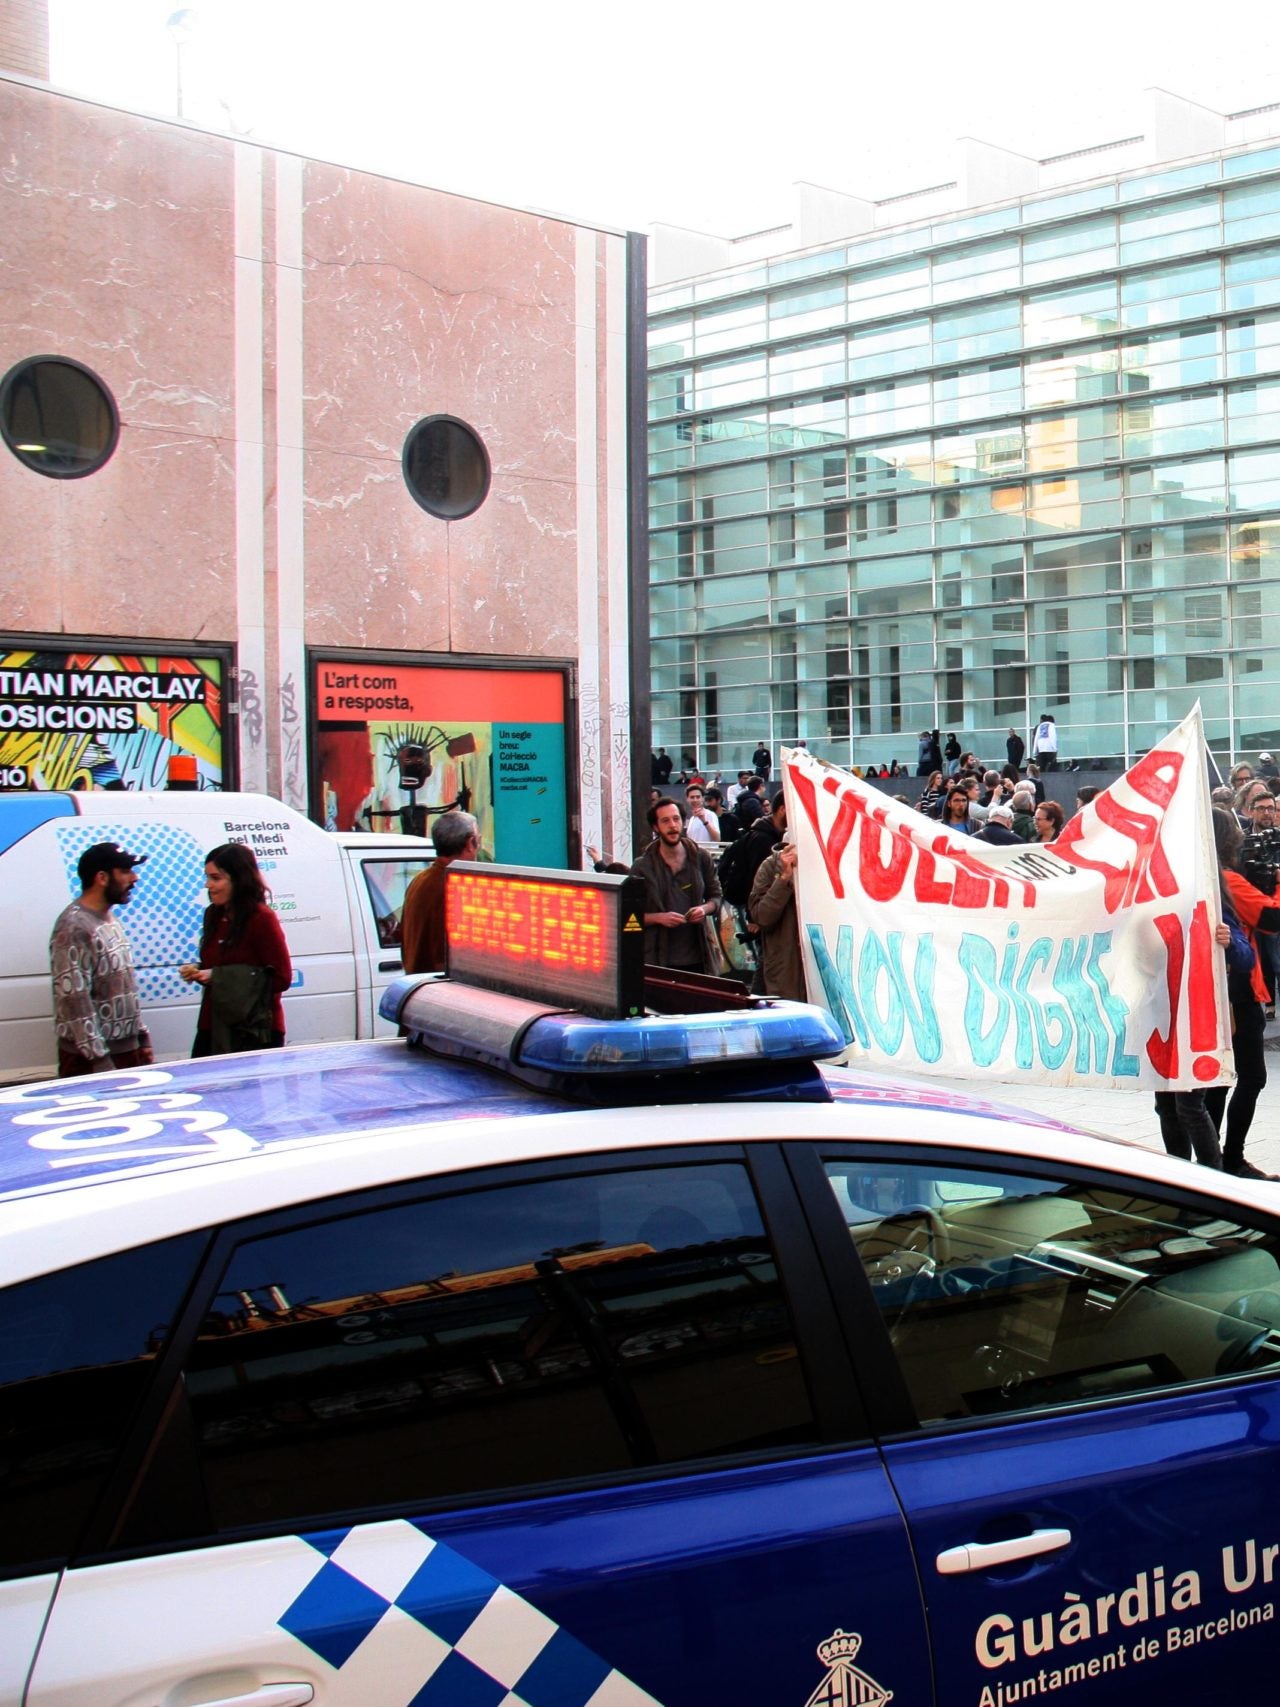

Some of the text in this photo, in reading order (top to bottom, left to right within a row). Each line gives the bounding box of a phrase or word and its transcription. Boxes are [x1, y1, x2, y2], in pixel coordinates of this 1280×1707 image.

[70, 674, 204, 700] MARCLAY.
[324, 671, 397, 690] L'art com
[325, 695, 414, 713] a resposta,
[224, 821, 290, 832] Barcelona
[228, 833, 284, 845] pel Medi
[806, 923, 943, 1064] NOU
[975, 1566, 1201, 1670] Guàrdia
[978, 1602, 1275, 1707] Ajuntament de Barcelona
